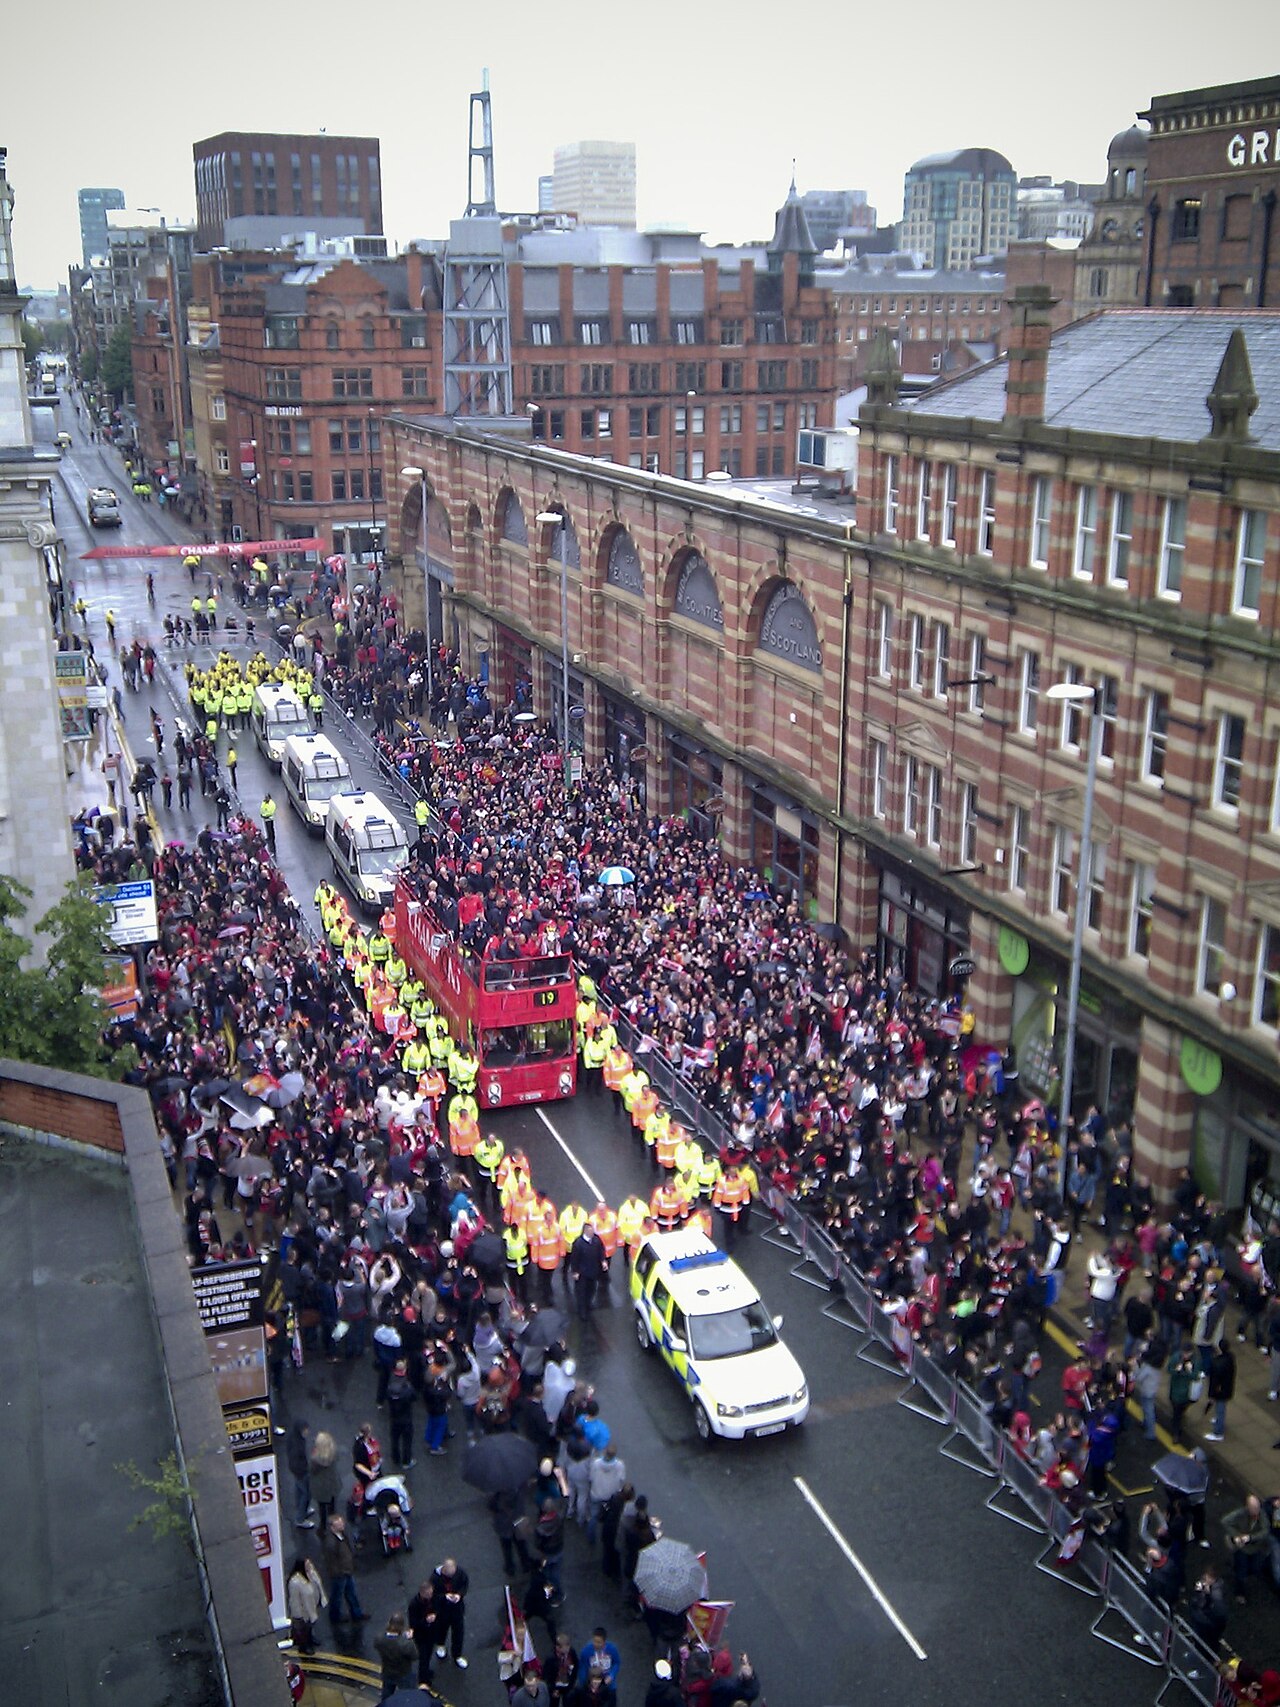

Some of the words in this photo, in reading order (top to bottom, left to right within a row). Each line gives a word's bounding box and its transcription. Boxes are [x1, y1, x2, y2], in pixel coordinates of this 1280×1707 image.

[180, 544, 243, 556] CHAMPONS
[685, 596, 724, 624] COUNTIES
[770, 630, 823, 665] SCOTLAND
[407, 906, 461, 995] CHAMPONS
[541, 992, 554, 1005] 19
[202, 1294, 230, 1307] FLOOR
[231, 1289, 260, 1301] OFFICE
[211, 1301, 250, 1315] FLEXIBLE
[242, 1428, 267, 1440] 9991
